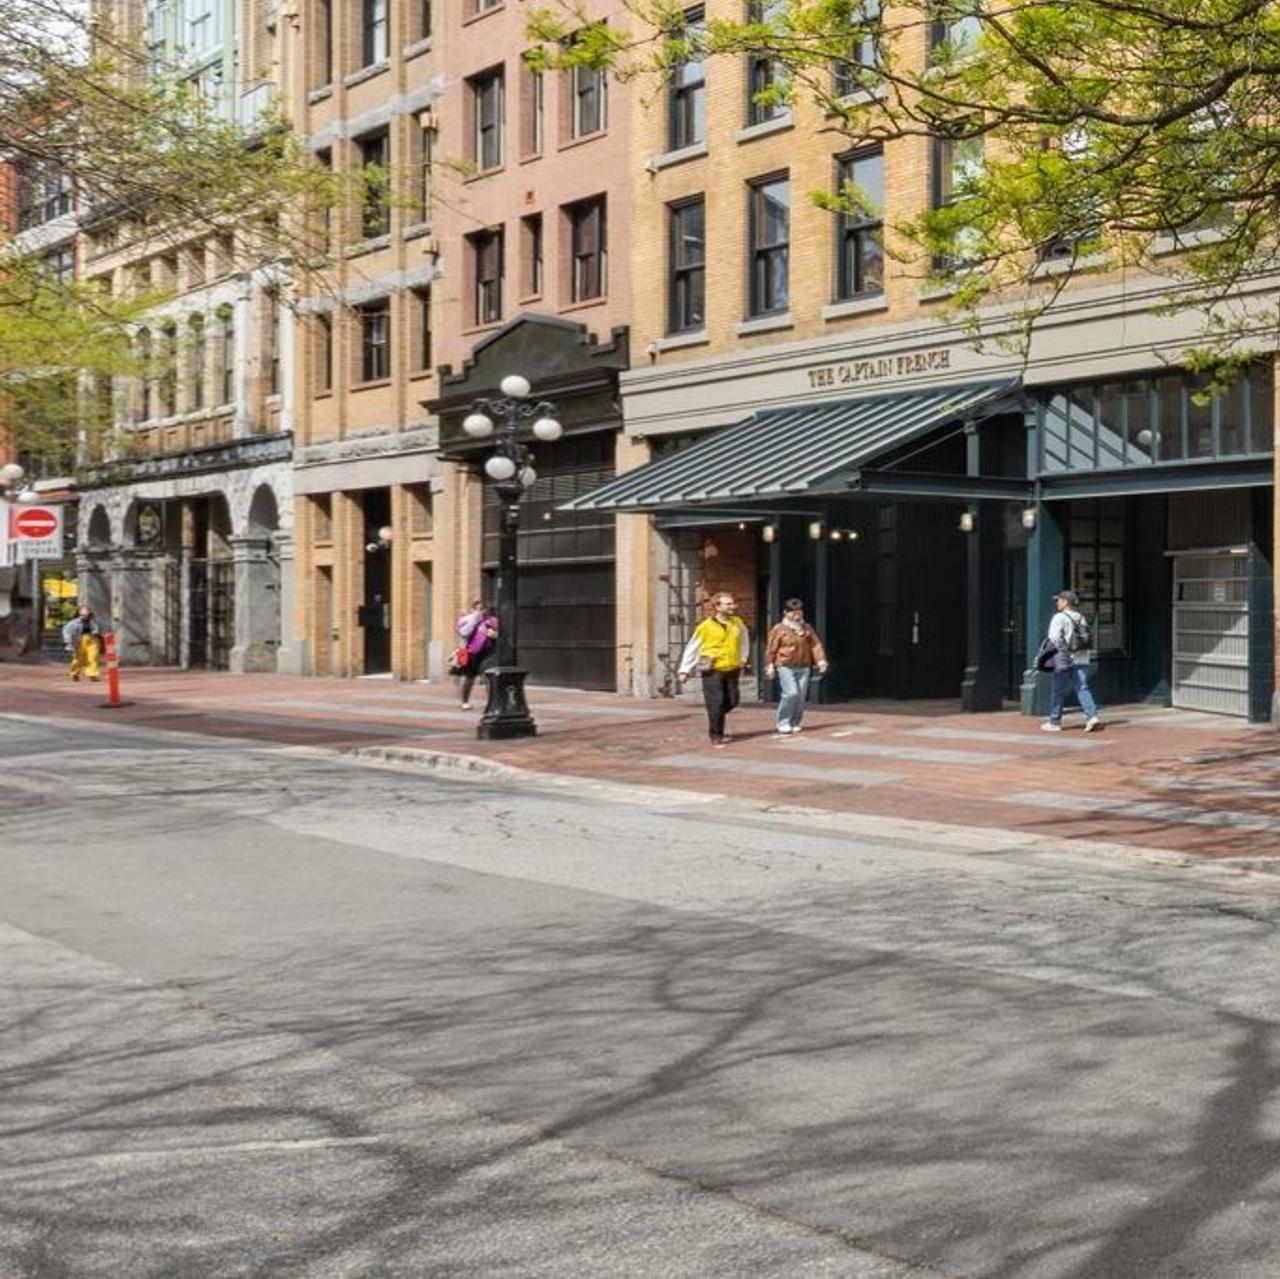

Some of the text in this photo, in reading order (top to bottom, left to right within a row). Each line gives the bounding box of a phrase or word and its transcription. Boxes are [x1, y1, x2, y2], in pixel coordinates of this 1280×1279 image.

[808, 349, 950, 388] THE CAPTAIN FRENCH
